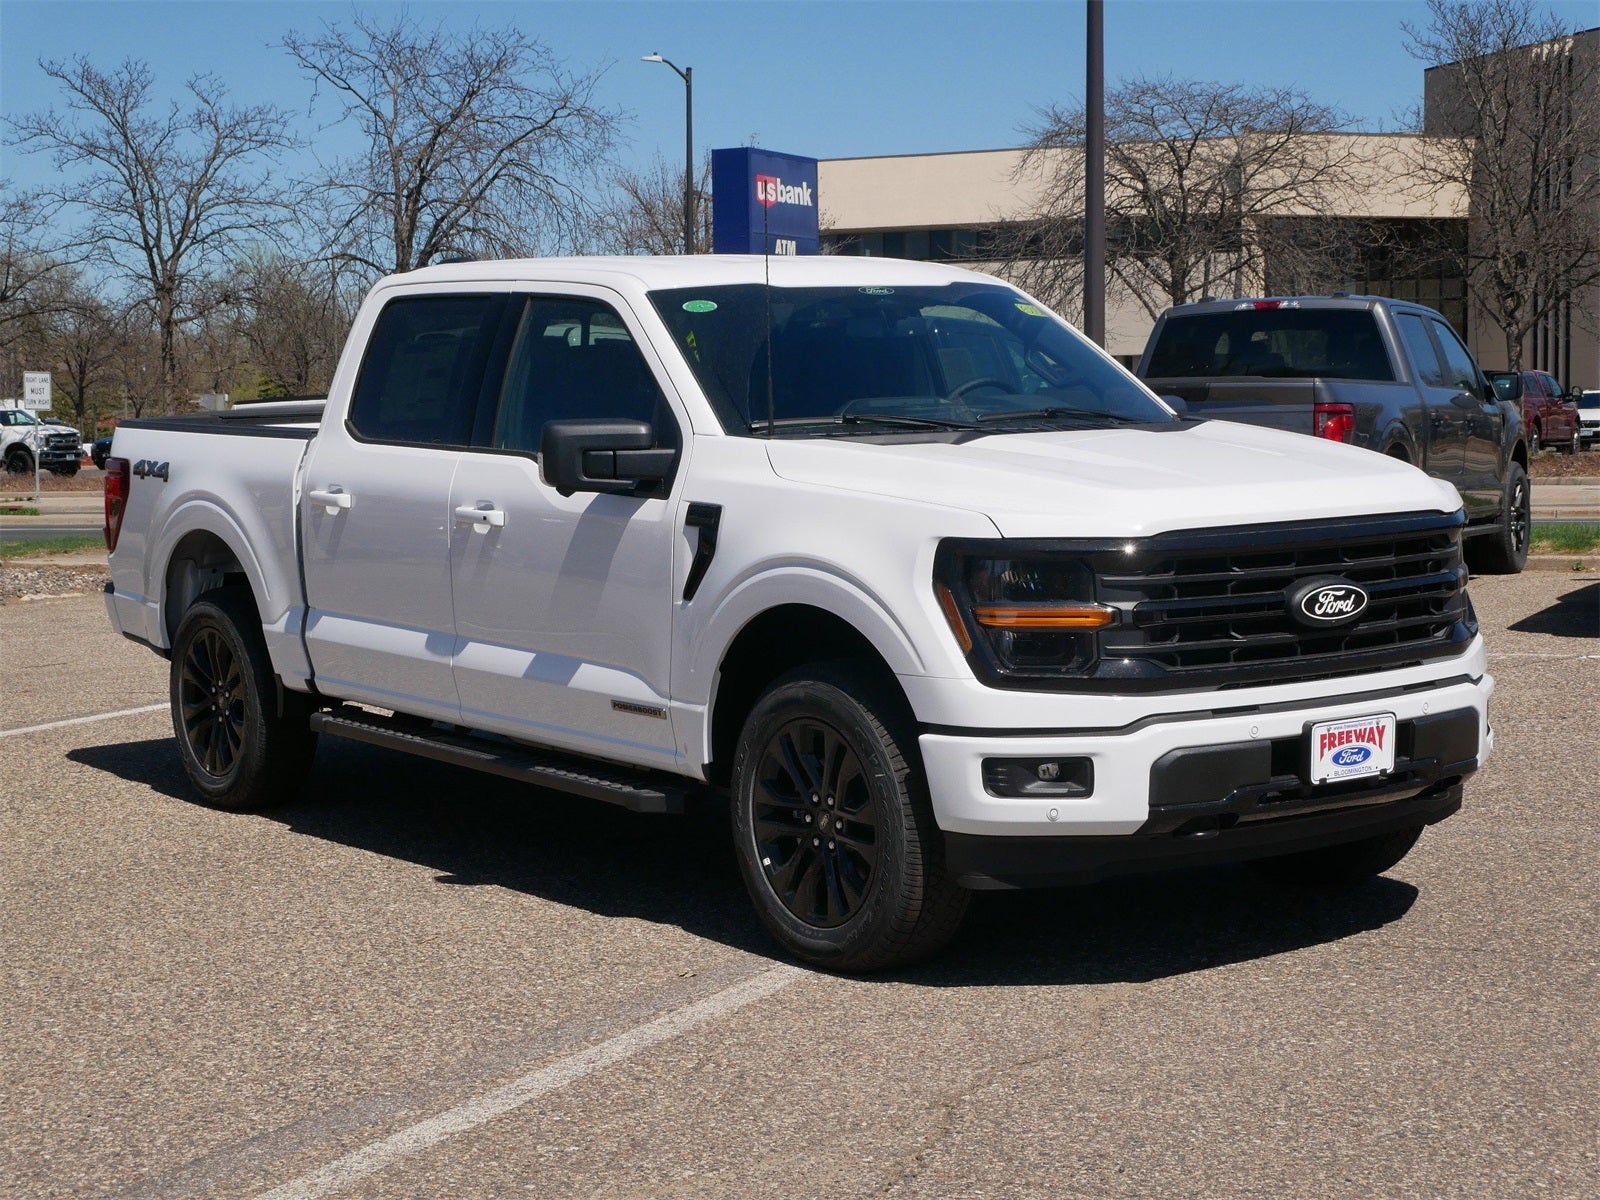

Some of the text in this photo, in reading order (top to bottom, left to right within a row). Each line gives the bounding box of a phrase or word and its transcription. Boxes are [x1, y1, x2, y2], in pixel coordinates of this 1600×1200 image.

[775, 239, 796, 255] ATM
[30, 387, 45, 395] MUST
[1314, 590, 1355, 615] Ford
[1320, 725, 1386, 762] FREEWAY
[1338, 748, 1365, 764] Ford
[1333, 765, 1373, 777] BLOOMINGTON
